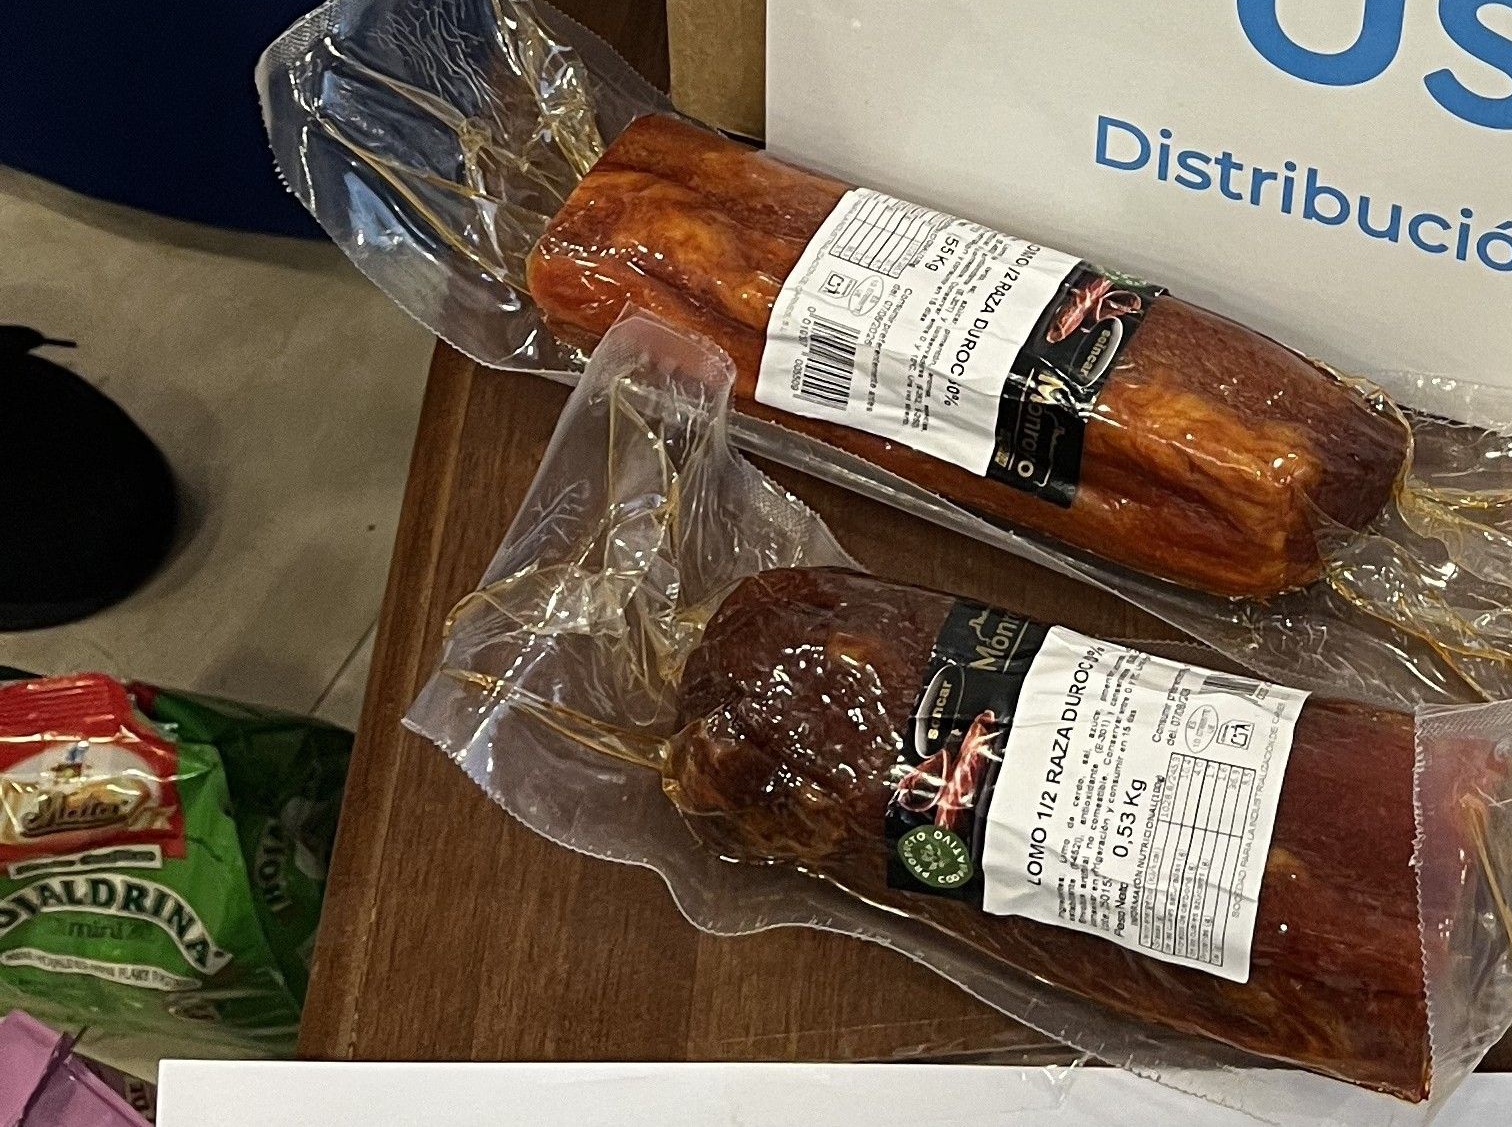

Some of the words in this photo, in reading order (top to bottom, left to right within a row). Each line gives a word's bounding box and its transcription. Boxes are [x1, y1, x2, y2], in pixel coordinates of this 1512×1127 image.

[979, 280, 1012, 316] RAZA
[949, 316, 989, 377] DUROC
[926, 679, 953, 740] soncar
[1059, 660, 1093, 723] DUROC
[1044, 723, 1073, 784] RAZA
[1034, 789, 1058, 822] 1/2
[1122, 777, 1147, 808] Kg
[1026, 825, 1048, 886] LOMO
[1111, 810, 1137, 859] 0,53
